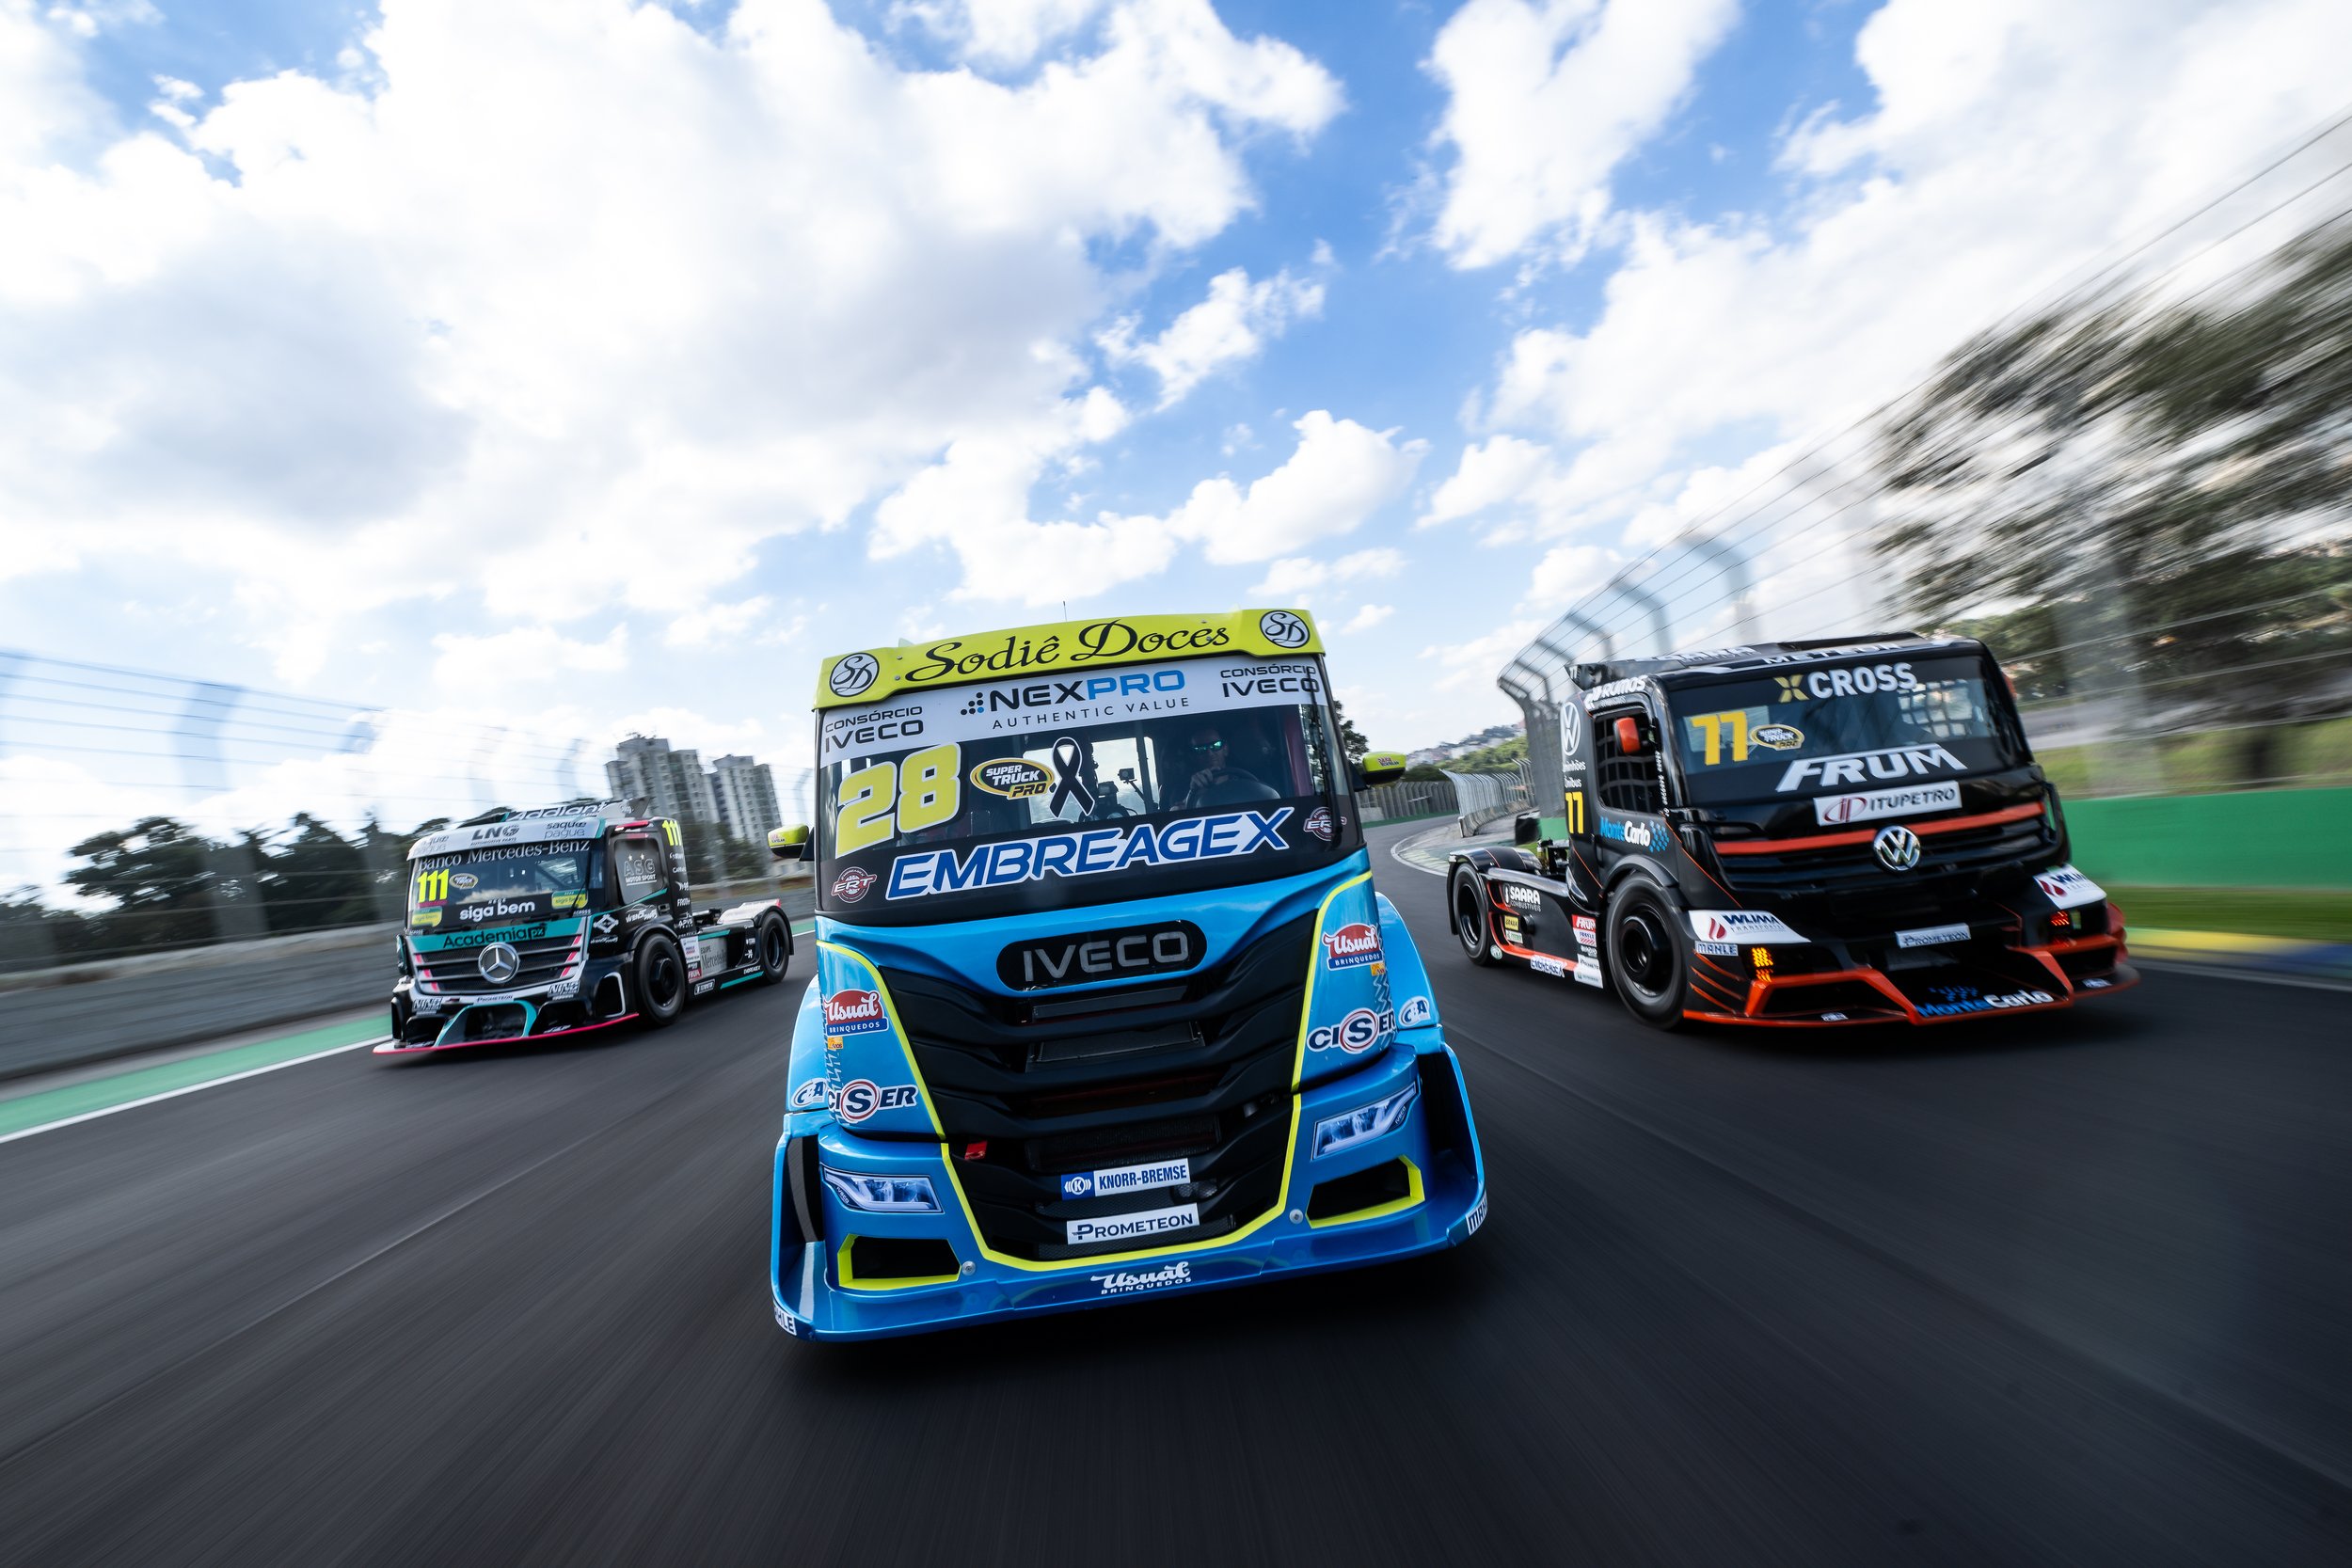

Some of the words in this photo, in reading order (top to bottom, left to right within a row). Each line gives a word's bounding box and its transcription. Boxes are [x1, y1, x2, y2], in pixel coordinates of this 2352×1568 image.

[905, 635, 1060, 681] Sodiê
[1071, 619, 1230, 661] Doces
[990, 670, 1185, 712] NEXPRO
[1222, 677, 1320, 697] IVECO
[825, 705, 923, 734] CONSÓRCIO
[993, 706, 1114, 730] AUTHENTIC
[1126, 697, 1189, 713] VALUE
[824, 720, 924, 753] IVECO
[1691, 711, 1748, 766] 77
[986, 765, 1023, 777] SUPER
[993, 770, 1041, 786] TRUCK
[1775, 743, 1968, 792] FRUM
[835, 742, 961, 859] 28
[1011, 783, 1046, 798] PRO
[1870, 788, 1956, 812] ITUPETRO
[467, 840, 590, 864] Mercedes-Benz
[885, 806, 1295, 900] EMBREAGEX
[417, 868, 450, 903] 111
[834, 877, 874, 893] ERT
[1510, 886, 1541, 904] SAARA
[459, 904, 494, 922] siga
[498, 901, 535, 916] bem
[1023, 930, 1189, 982] IVECO
[1335, 952, 1380, 966] BRINQUEDOS
[823, 992, 879, 1022] Usual
[829, 1021, 881, 1034] BRINQUEDOS
[828, 1085, 917, 1114] CISER
[1099, 1164, 1187, 1190] KNORR-BREMSE
[1072, 1213, 1193, 1241] PROMETEON
[1090, 1261, 1191, 1289] Usual
[1101, 1276, 1192, 1295] BRINQUEDOS
